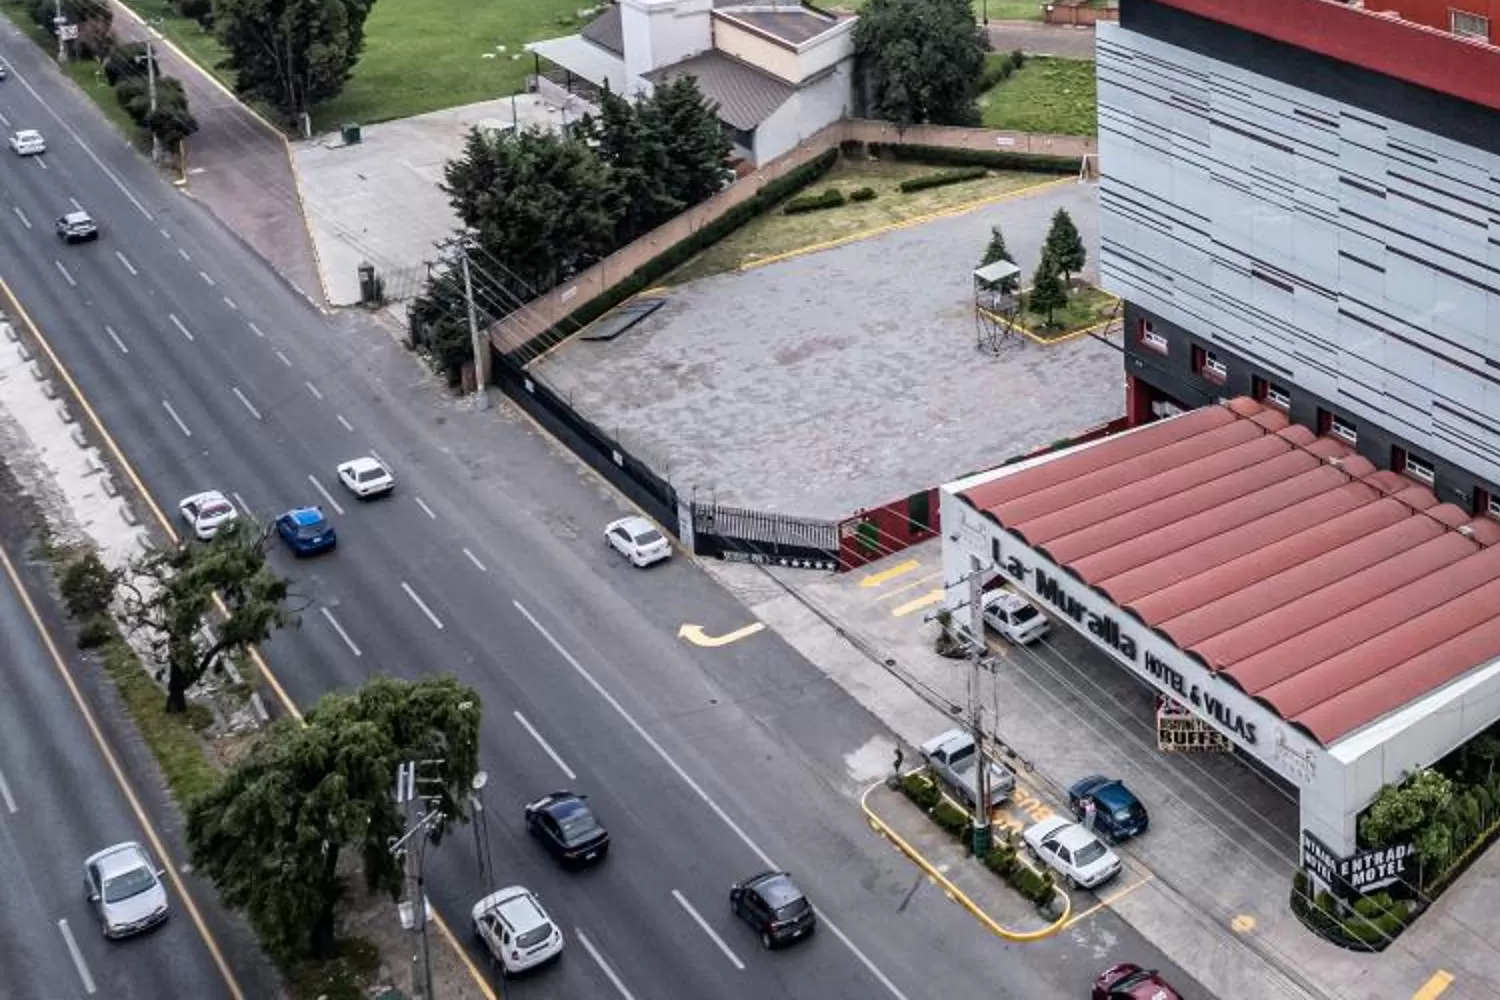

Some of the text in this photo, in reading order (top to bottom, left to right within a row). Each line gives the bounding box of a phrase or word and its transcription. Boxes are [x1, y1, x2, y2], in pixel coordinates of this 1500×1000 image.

[991, 537, 1258, 745] La Muralla HOTEL & VILLAS
[1341, 842, 1415, 877] ENTRADA
[1351, 859, 1405, 886] MOTEL
